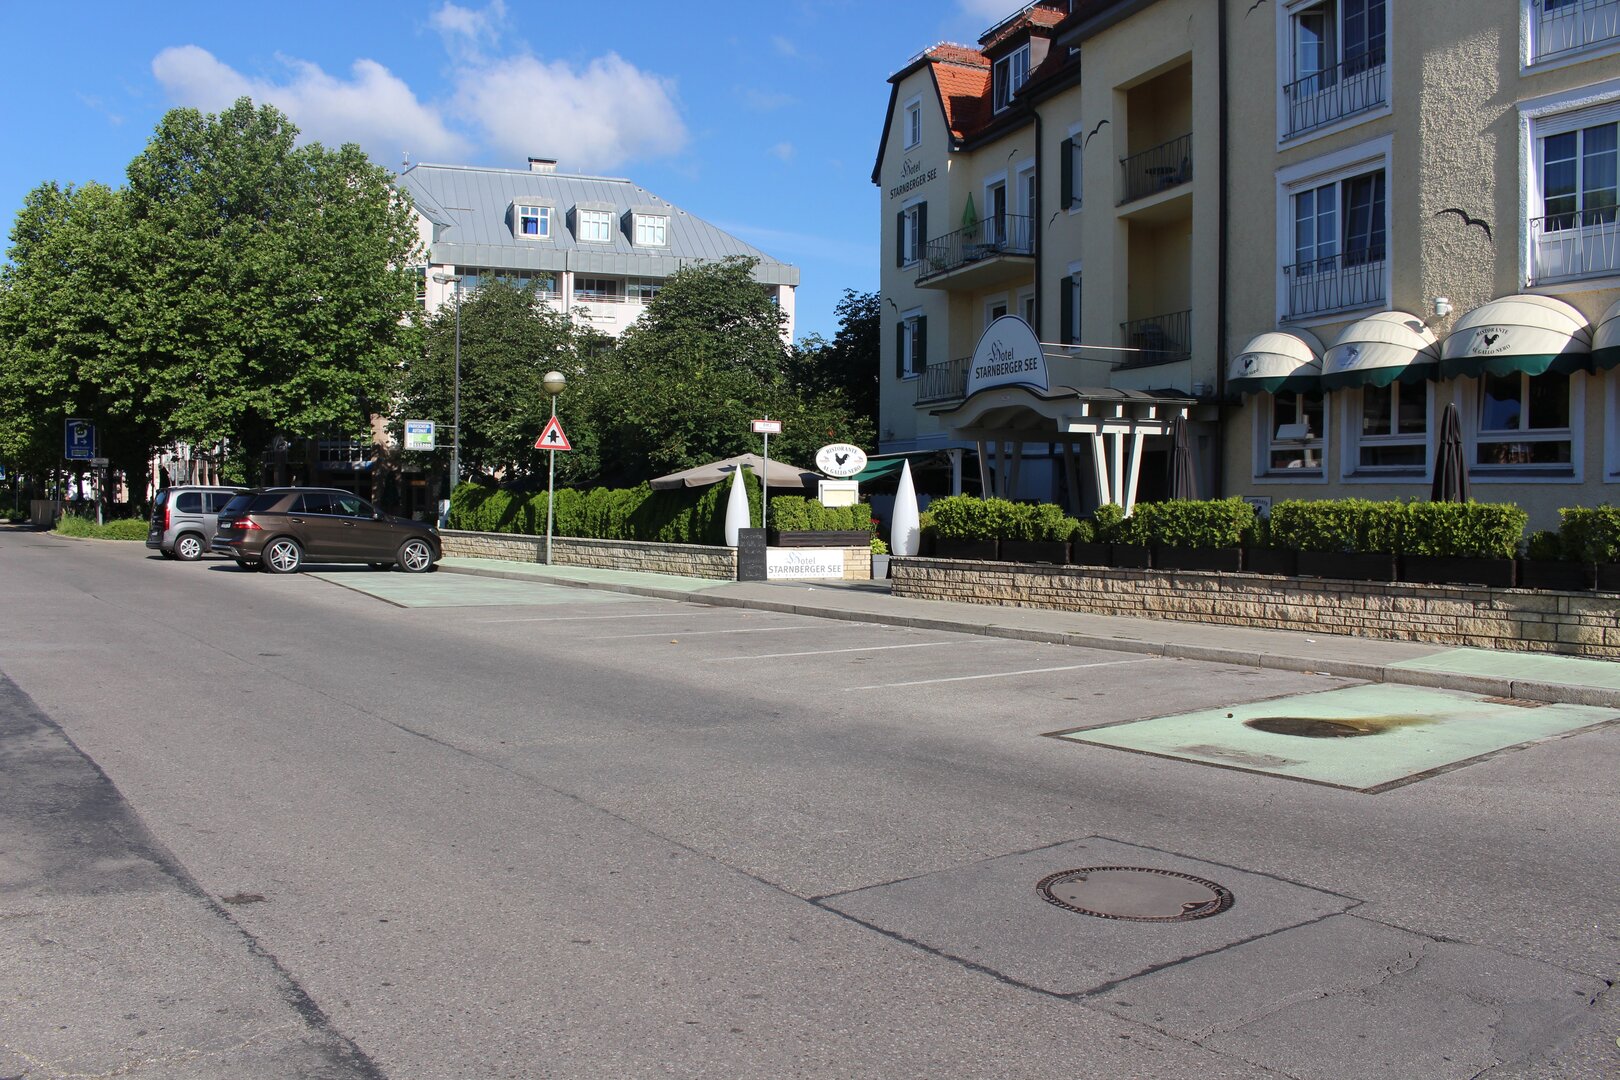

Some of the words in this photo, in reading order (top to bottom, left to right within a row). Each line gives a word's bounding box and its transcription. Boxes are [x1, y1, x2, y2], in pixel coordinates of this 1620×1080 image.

[901, 158, 920, 179] Hotel
[890, 173, 926, 200] STARNBERGER
[927, 167, 937, 182] SEE
[1476, 327, 1509, 337] RISTORANTE
[987, 339, 1014, 363] Hotel
[1495, 344, 1511, 353] NERO
[975, 360, 1023, 379] STARNBERGER
[1024, 357, 1038, 372] SEE
[826, 446, 858, 455] RISTORANTE
[823, 465, 829, 473] AL
[848, 465, 862, 474] NERO
[787, 551, 816, 565] Hotel
[768, 565, 826, 574] STARNBERGER
[827, 564, 841, 573] SEE
